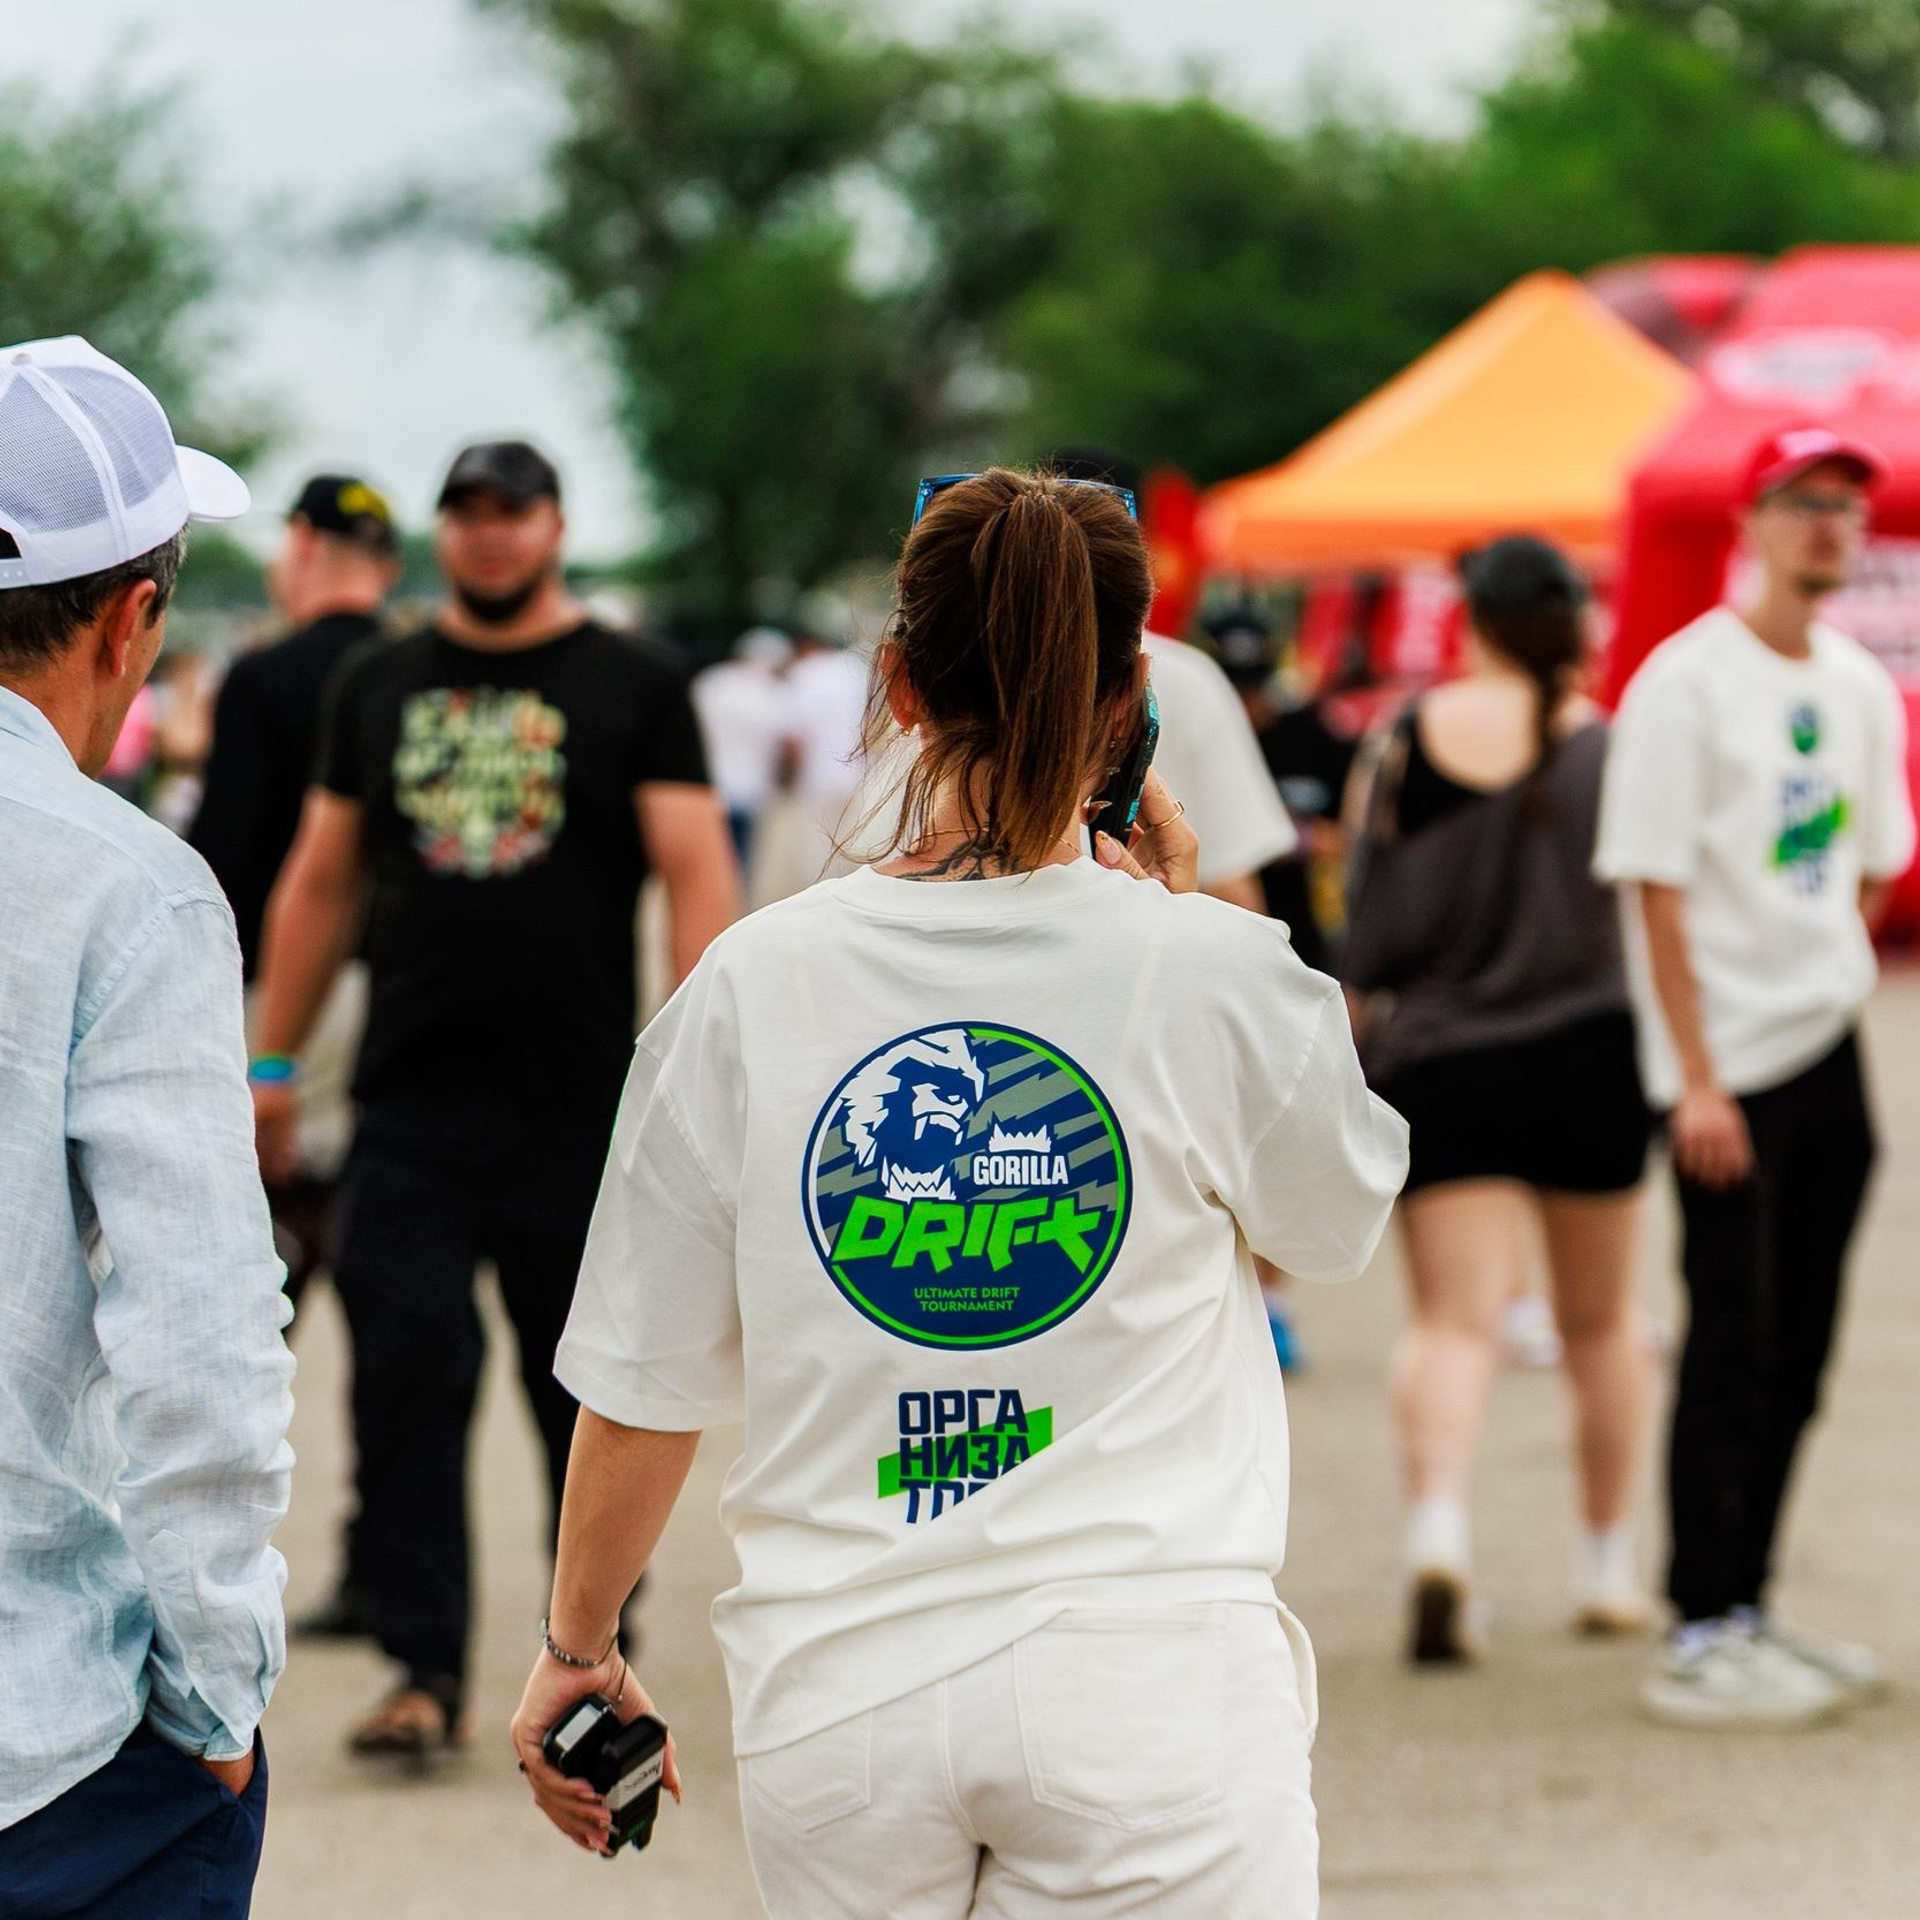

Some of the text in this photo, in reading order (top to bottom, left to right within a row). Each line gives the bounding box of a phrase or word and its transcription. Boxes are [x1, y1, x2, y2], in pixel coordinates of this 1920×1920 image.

[974, 1156, 1069, 1185] GORILLA
[832, 1195, 1101, 1274] DRIFT
[914, 1286, 1020, 1299] ULTIMATE DRIFT
[920, 1300, 1014, 1312] TOURNAMENT
[898, 1389, 1029, 1435] ОРГА
[900, 1435, 1031, 1479] НИЗА
